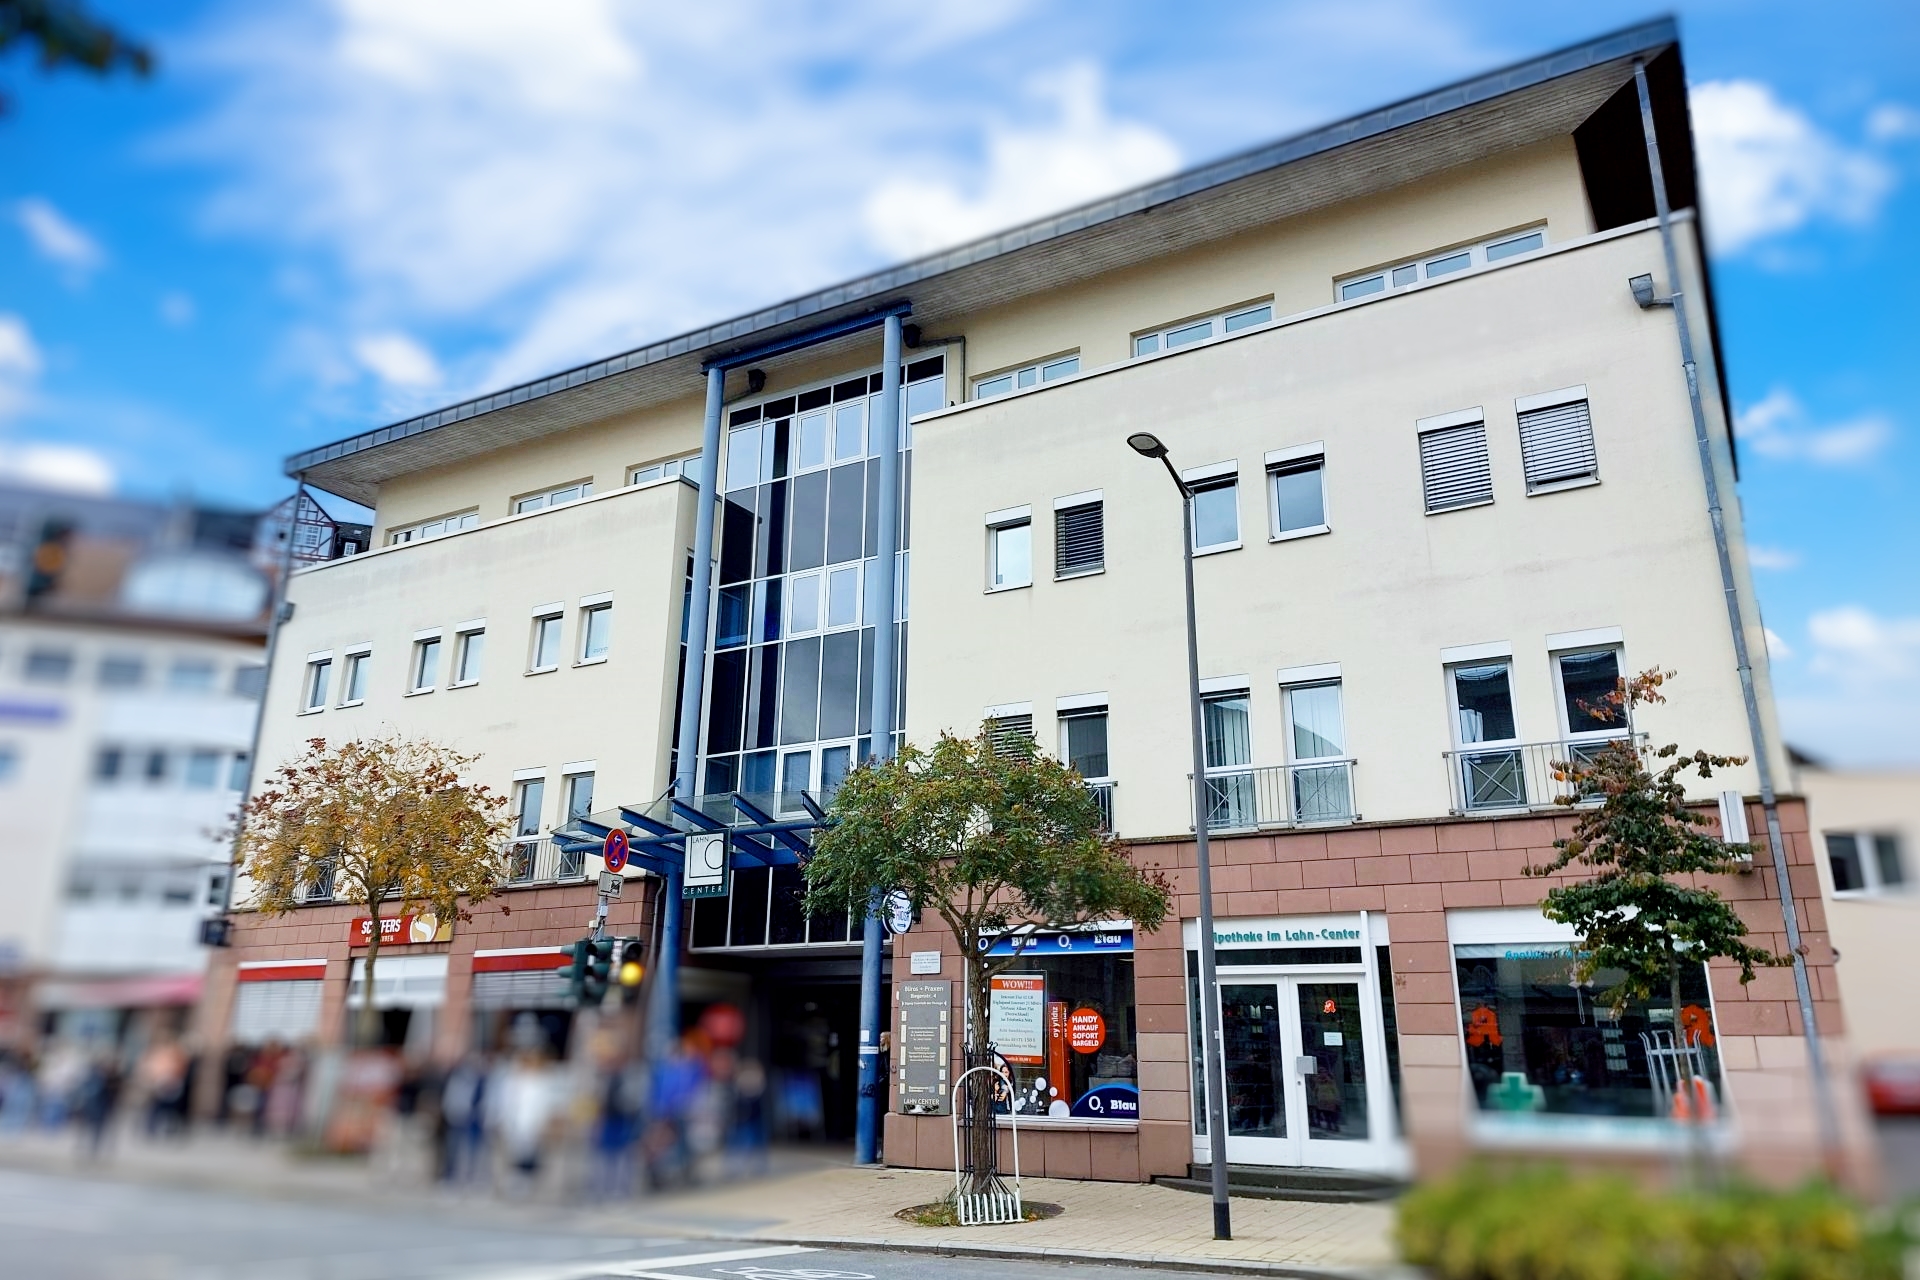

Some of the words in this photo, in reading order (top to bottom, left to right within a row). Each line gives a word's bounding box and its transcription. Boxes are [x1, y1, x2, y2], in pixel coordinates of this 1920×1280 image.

[683, 885, 723, 895] CENTER
[361, 919, 401, 935] SCFERS
[978, 937, 989, 950] O
[1058, 934, 1073, 950] O2
[1267, 931, 1281, 941] im
[1286, 929, 1360, 941] Lahn-Center
[1002, 980, 1033, 989] WOW!!!
[1088, 1095, 1104, 1114] O2
[1110, 1099, 1137, 1111] Blau
